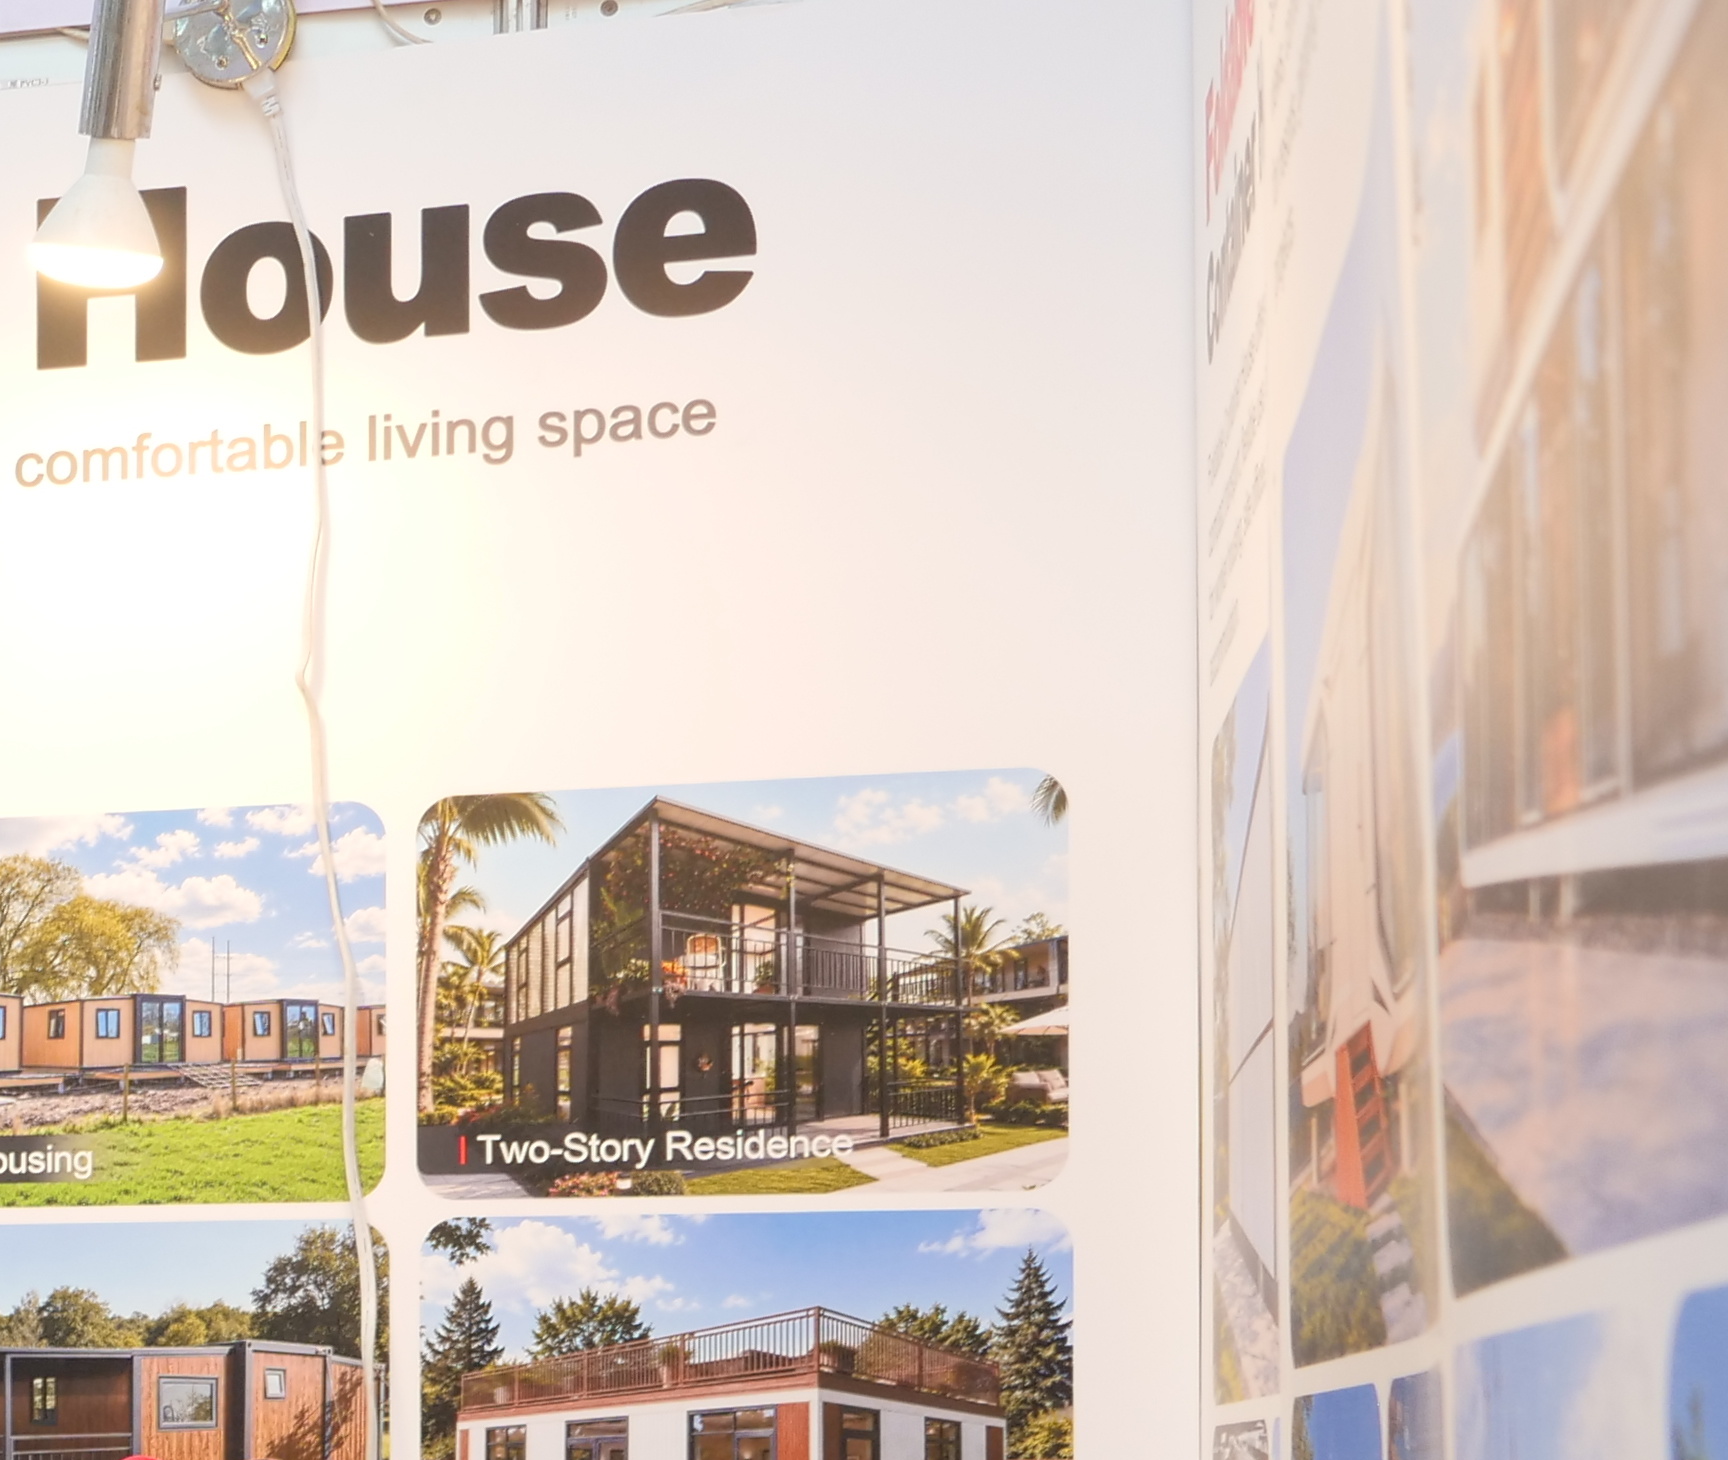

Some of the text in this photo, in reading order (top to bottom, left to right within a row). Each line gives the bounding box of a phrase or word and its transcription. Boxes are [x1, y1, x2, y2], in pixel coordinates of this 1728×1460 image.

[36, 176, 757, 370] House
[16, 422, 344, 490] comfortable
[367, 405, 514, 465] living
[537, 392, 717, 459] space
[477, 1129, 854, 1175] Two-Story Residence
